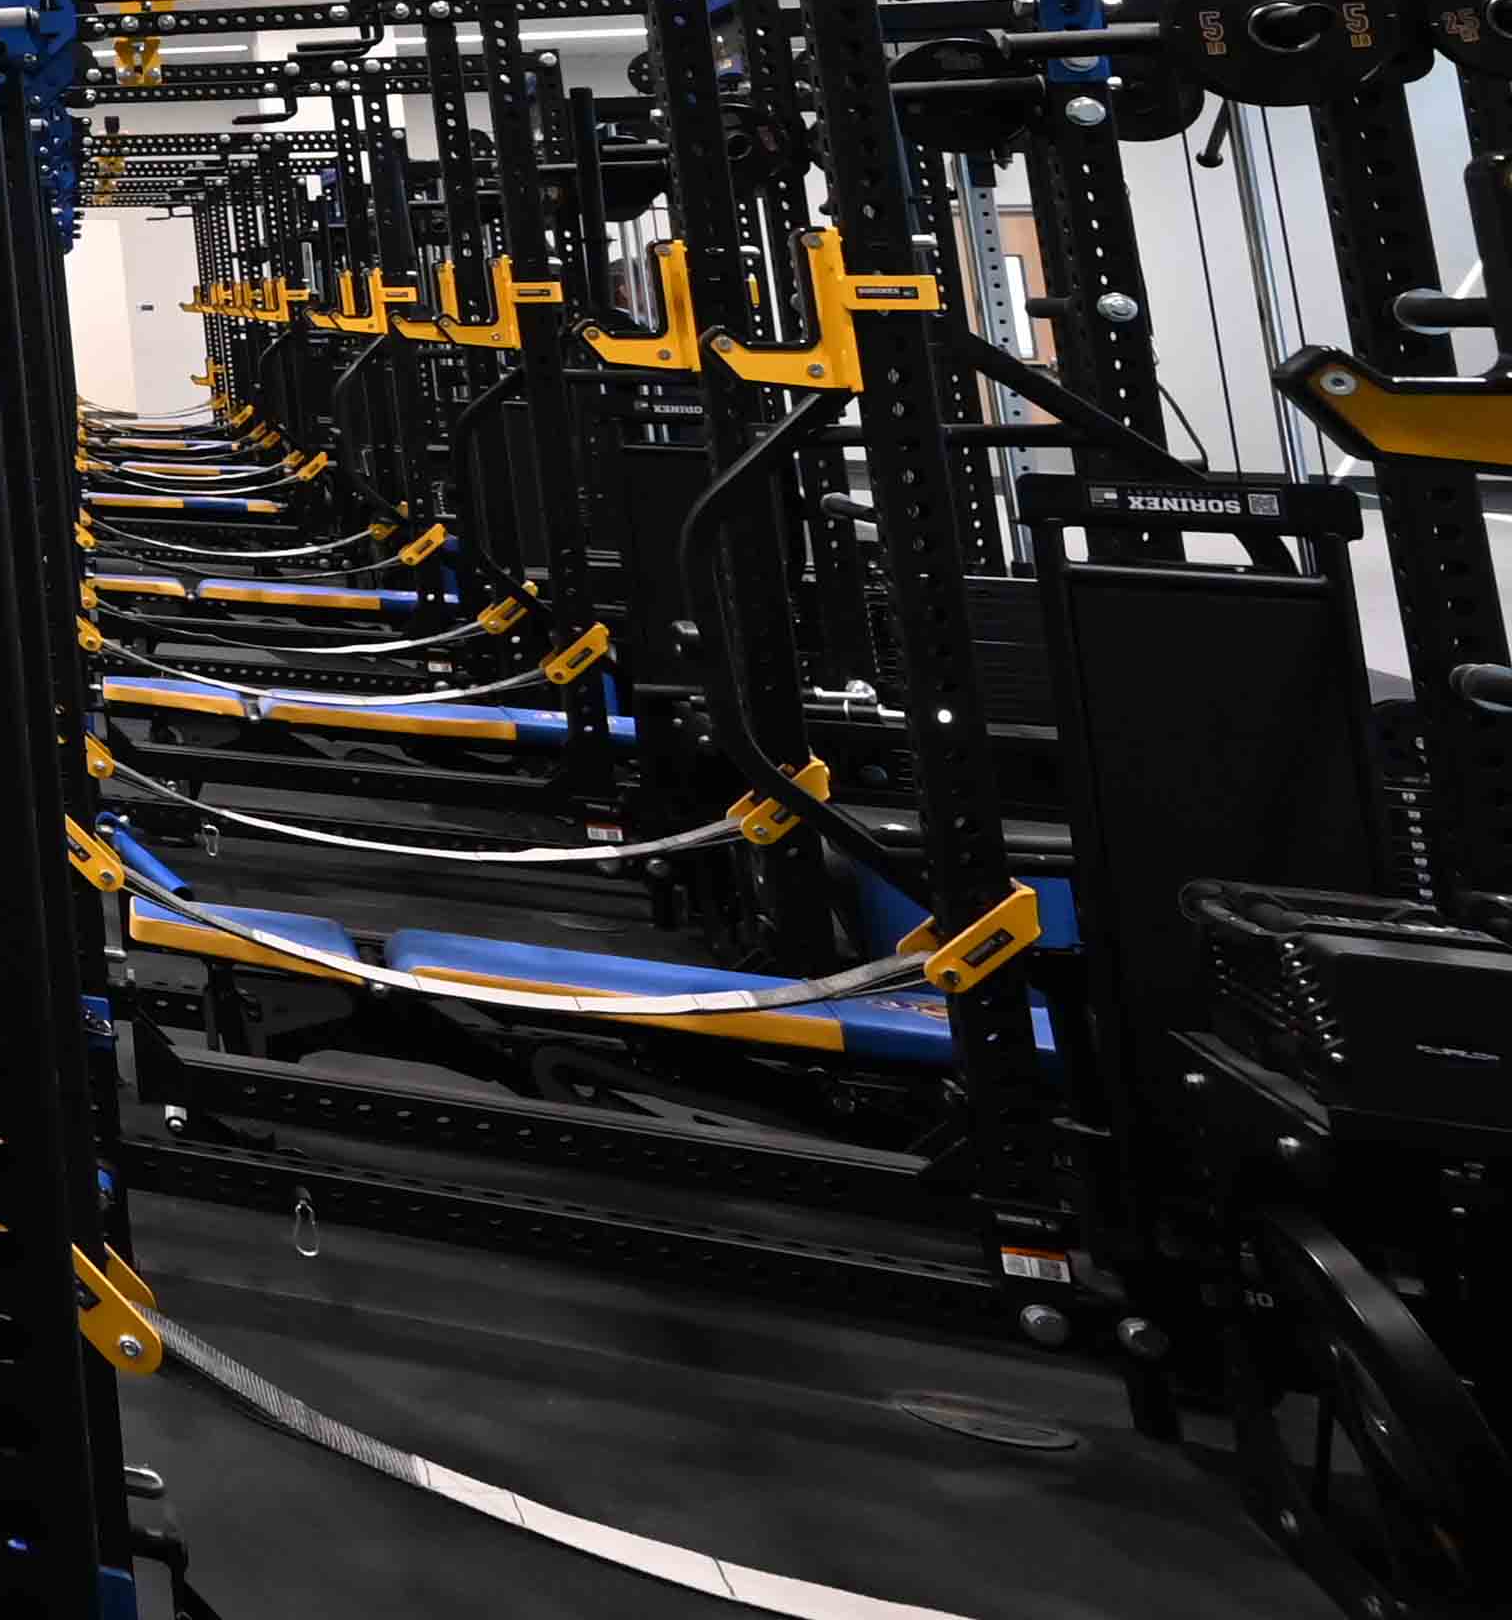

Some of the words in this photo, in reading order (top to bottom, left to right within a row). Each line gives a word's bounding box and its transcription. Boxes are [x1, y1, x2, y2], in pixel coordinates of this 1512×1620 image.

[1199, 11, 1224, 41] 5
[1342, 3, 1369, 34] 5
[1127, 495, 1241, 514] SORINEX
